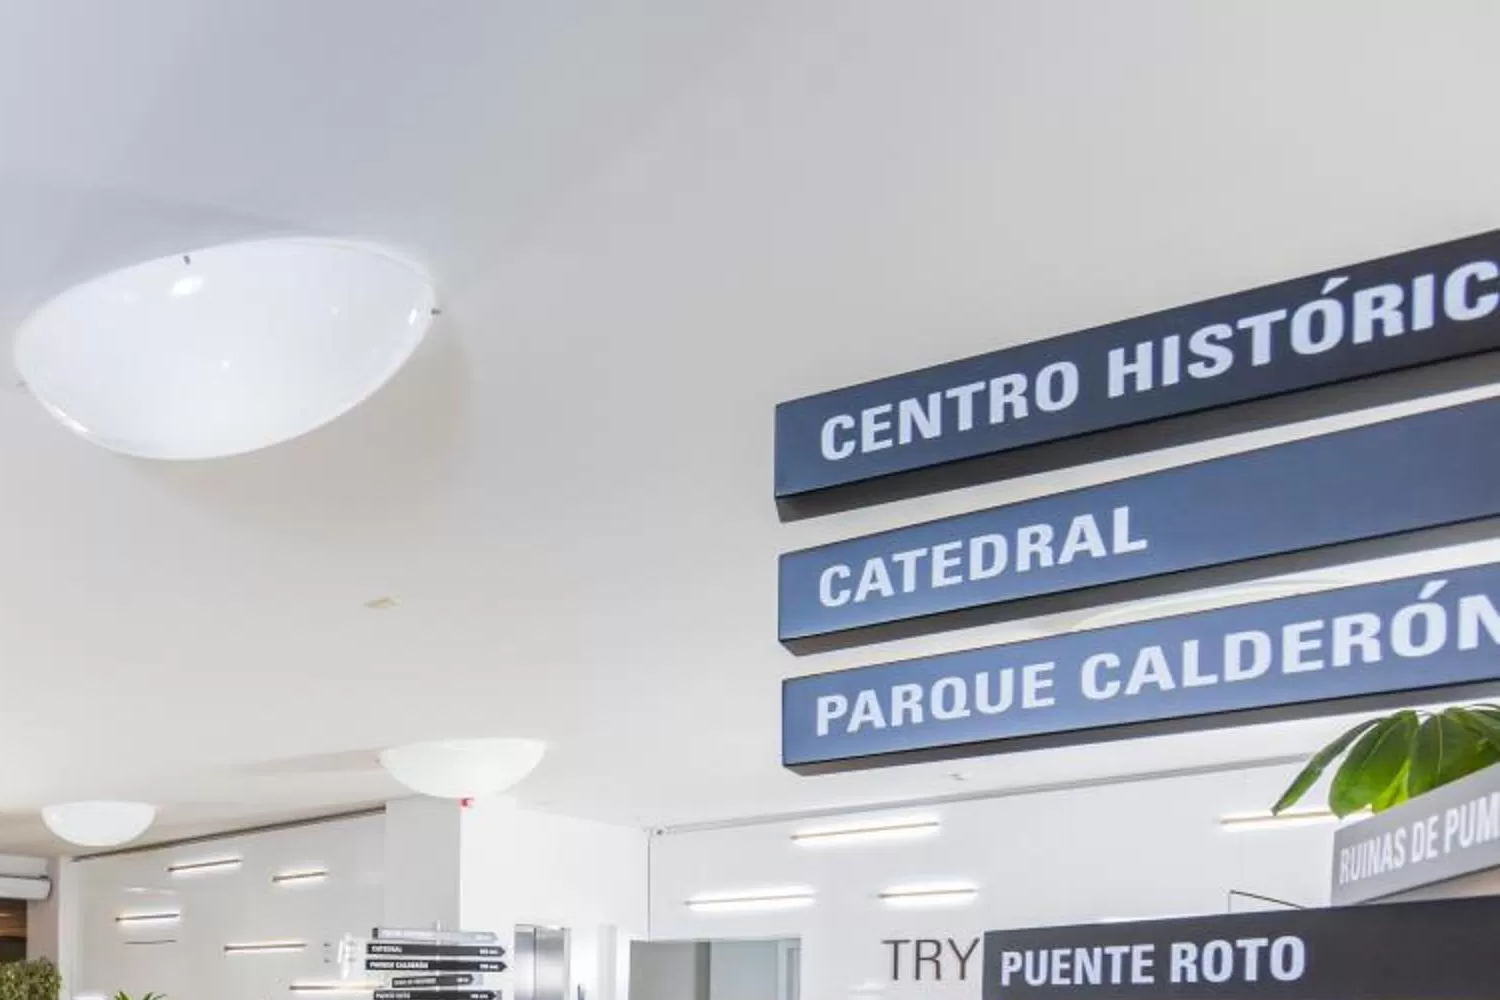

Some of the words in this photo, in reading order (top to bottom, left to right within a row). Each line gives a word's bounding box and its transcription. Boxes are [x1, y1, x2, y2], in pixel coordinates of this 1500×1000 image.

[819, 361, 1080, 461] CENTRO
[1107, 260, 1500, 399] HISTÓRIC
[819, 505, 1149, 608] CATEDRAL
[816, 661, 1056, 737] PARQUE
[1080, 579, 1500, 701] CALDERÓN
[1339, 827, 1406, 885] RUINAS
[1411, 815, 1439, 863] DE
[1444, 791, 1500, 854] PUM
[881, 938, 980, 981] TRY
[1000, 943, 1156, 987] PUENTE
[1170, 936, 1306, 984] ROTO
